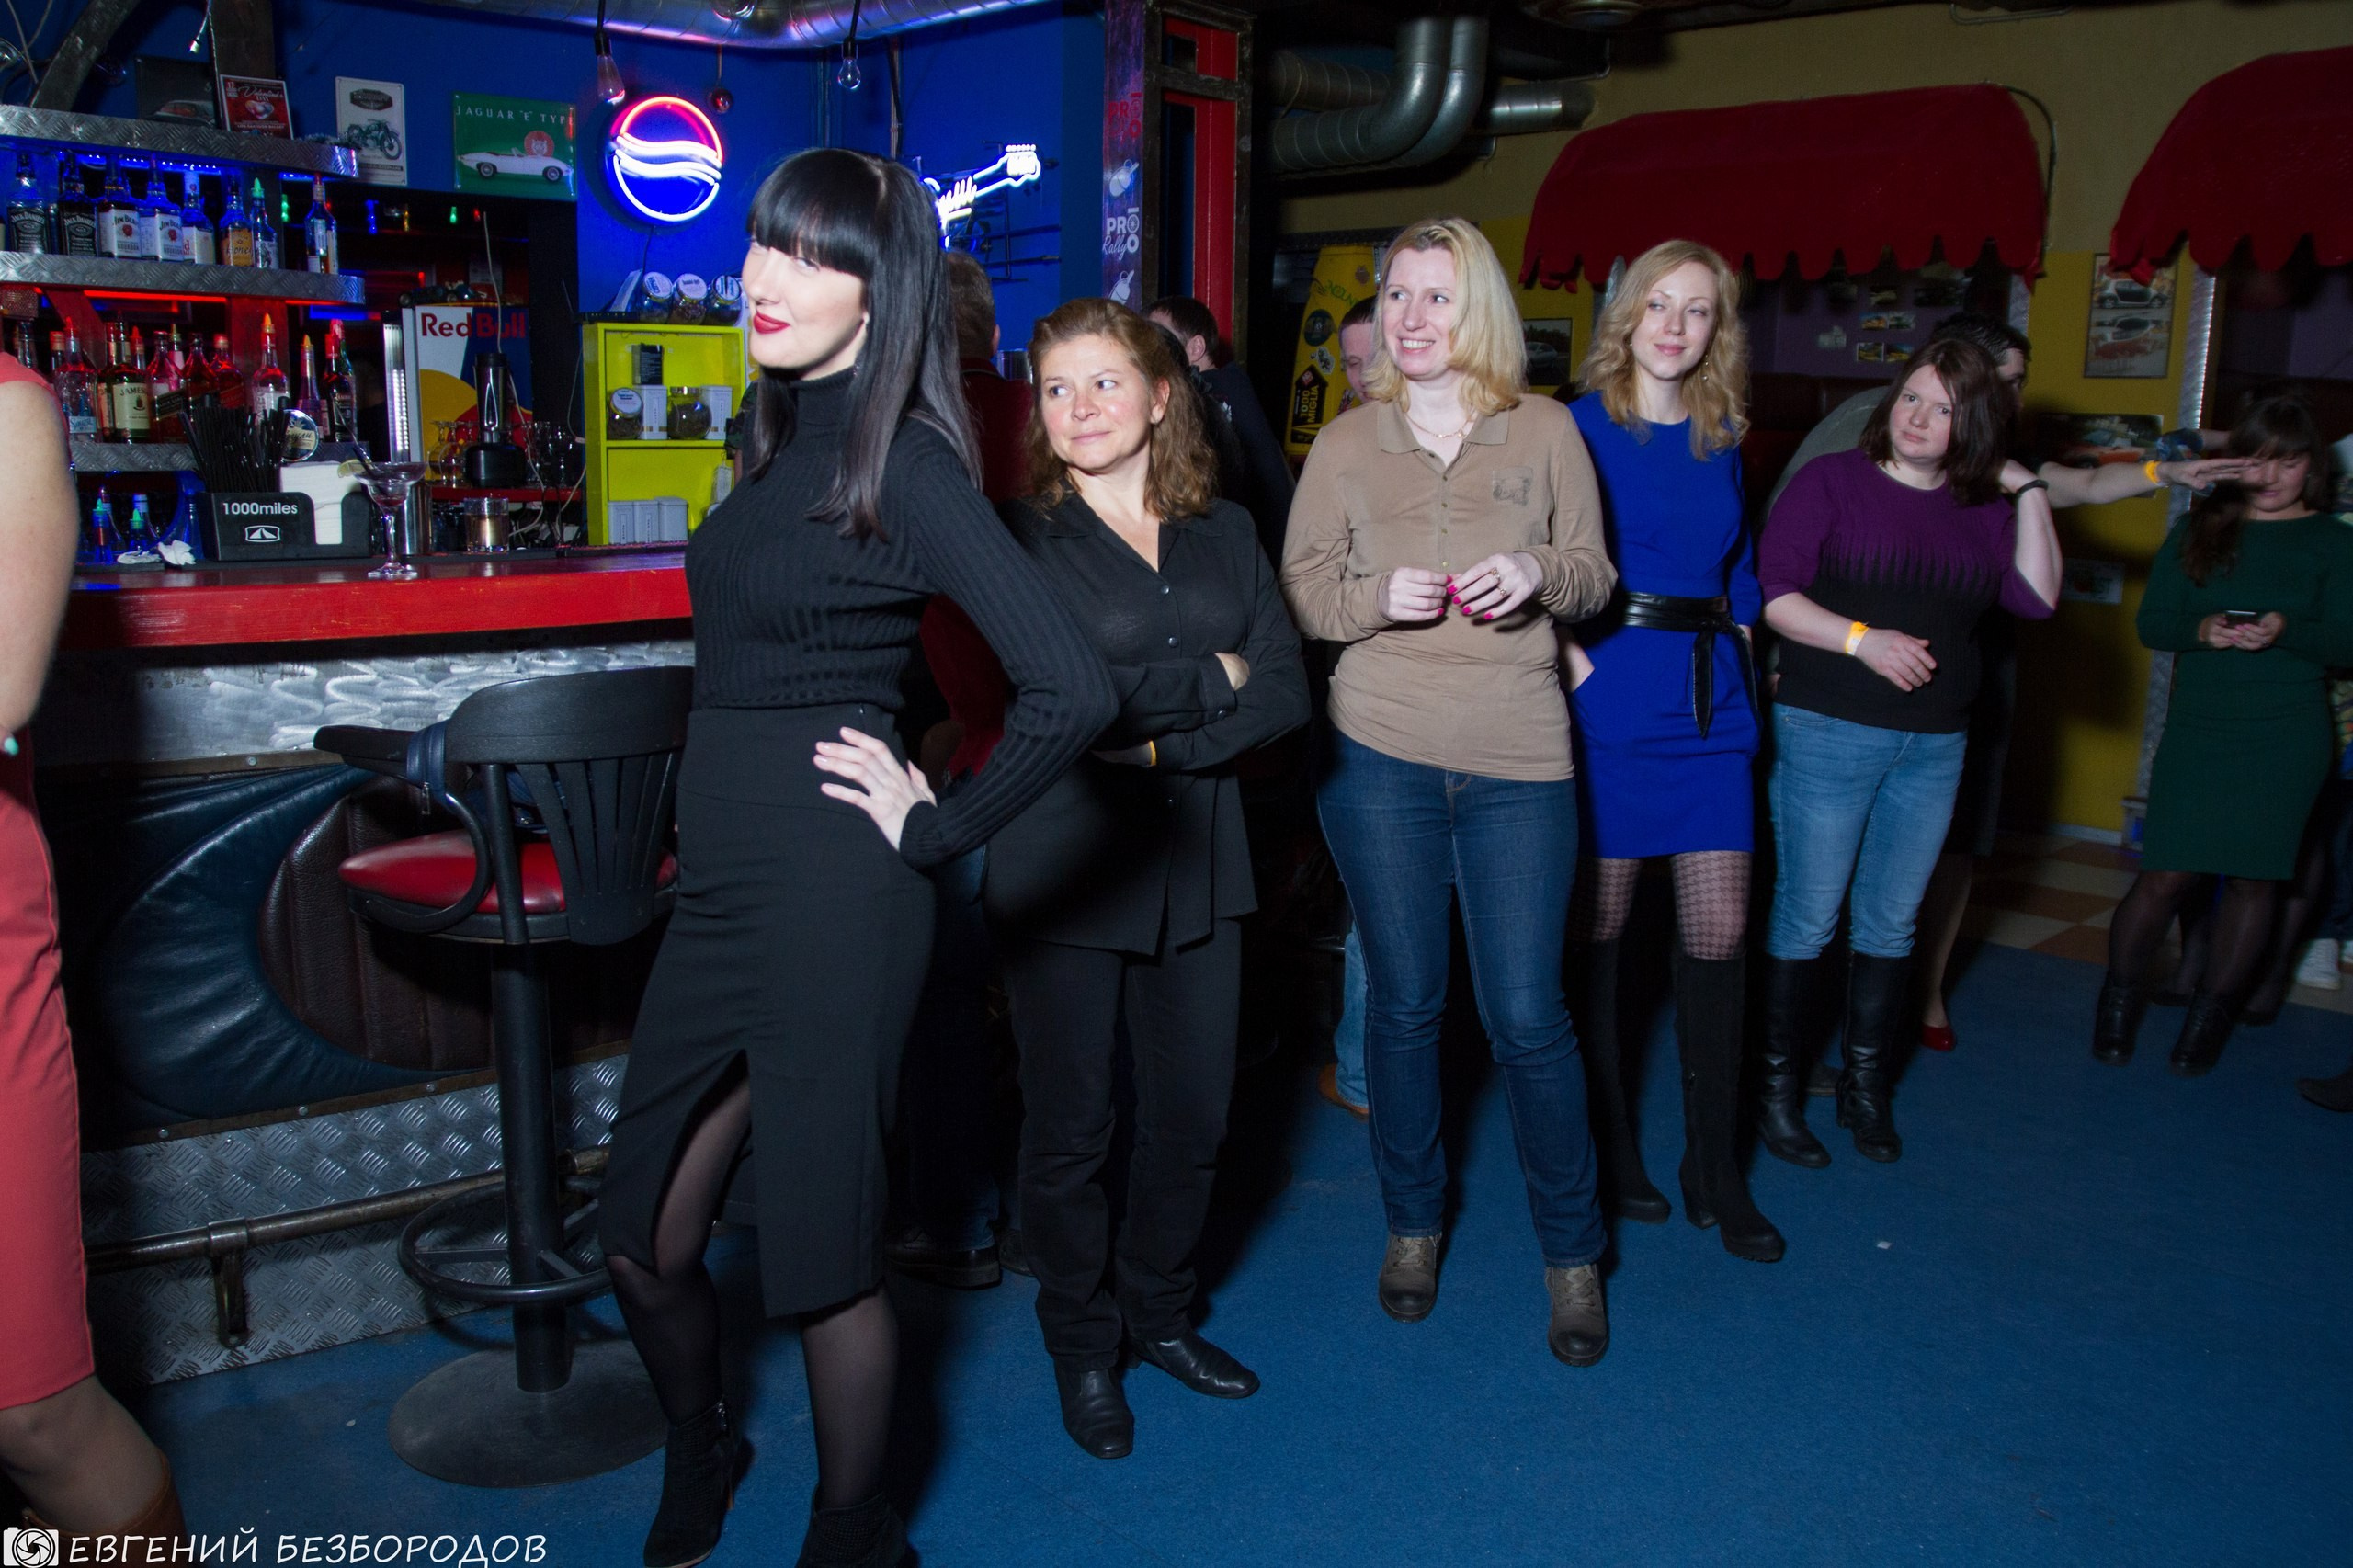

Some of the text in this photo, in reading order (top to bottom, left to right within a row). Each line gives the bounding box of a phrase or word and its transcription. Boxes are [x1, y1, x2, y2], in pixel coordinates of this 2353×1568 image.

[456, 105, 514, 119] JAGUAR
[421, 312, 526, 339] Red Bull
[1306, 384, 1320, 423] MIGLIA
[223, 502, 298, 515] 1000miles
